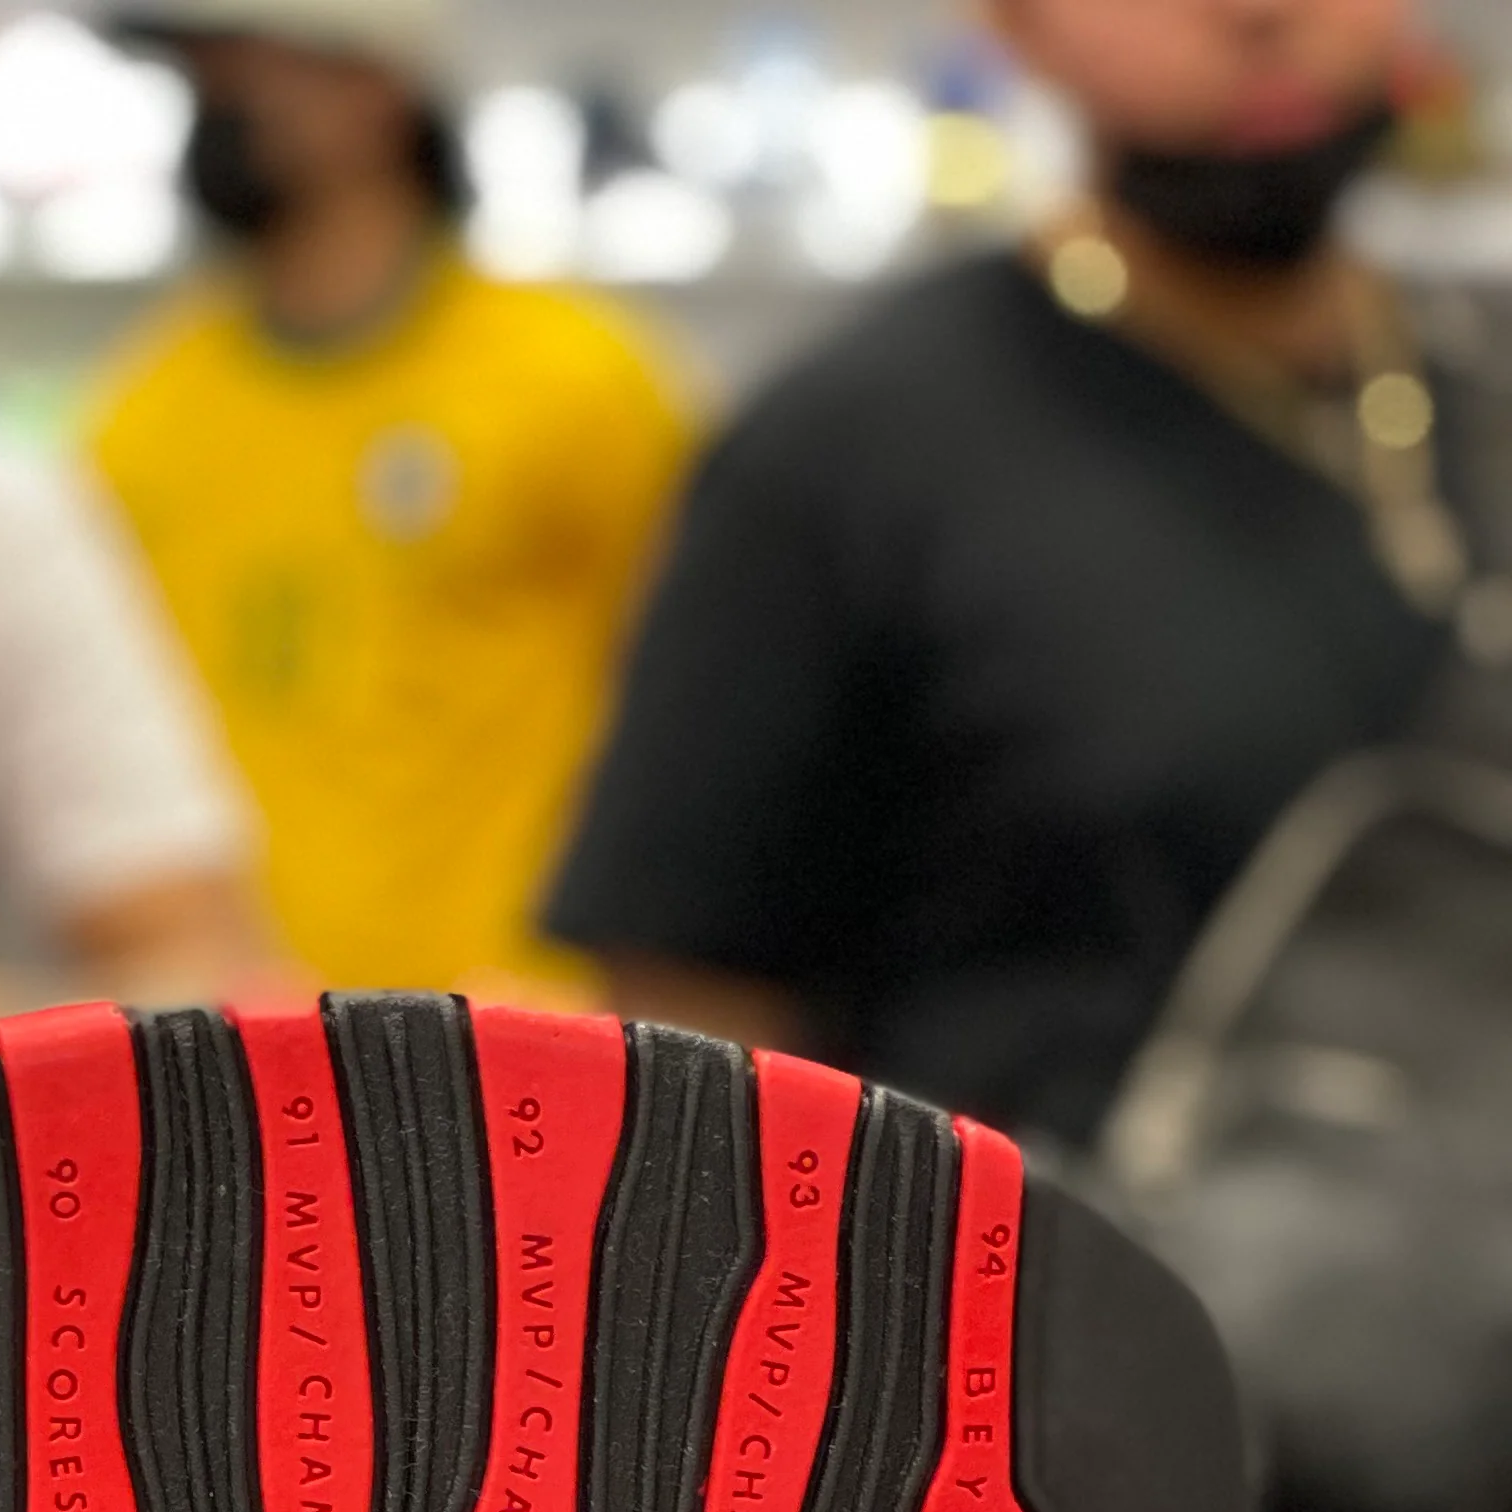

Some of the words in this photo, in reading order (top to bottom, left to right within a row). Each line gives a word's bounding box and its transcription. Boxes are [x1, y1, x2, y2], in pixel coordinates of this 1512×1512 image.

[280, 1094, 321, 1148] 91
[506, 1096, 545, 1158] 92
[44, 1157, 81, 1220] 90
[788, 1148, 821, 1209] 93
[976, 1223, 1011, 1279] 94
